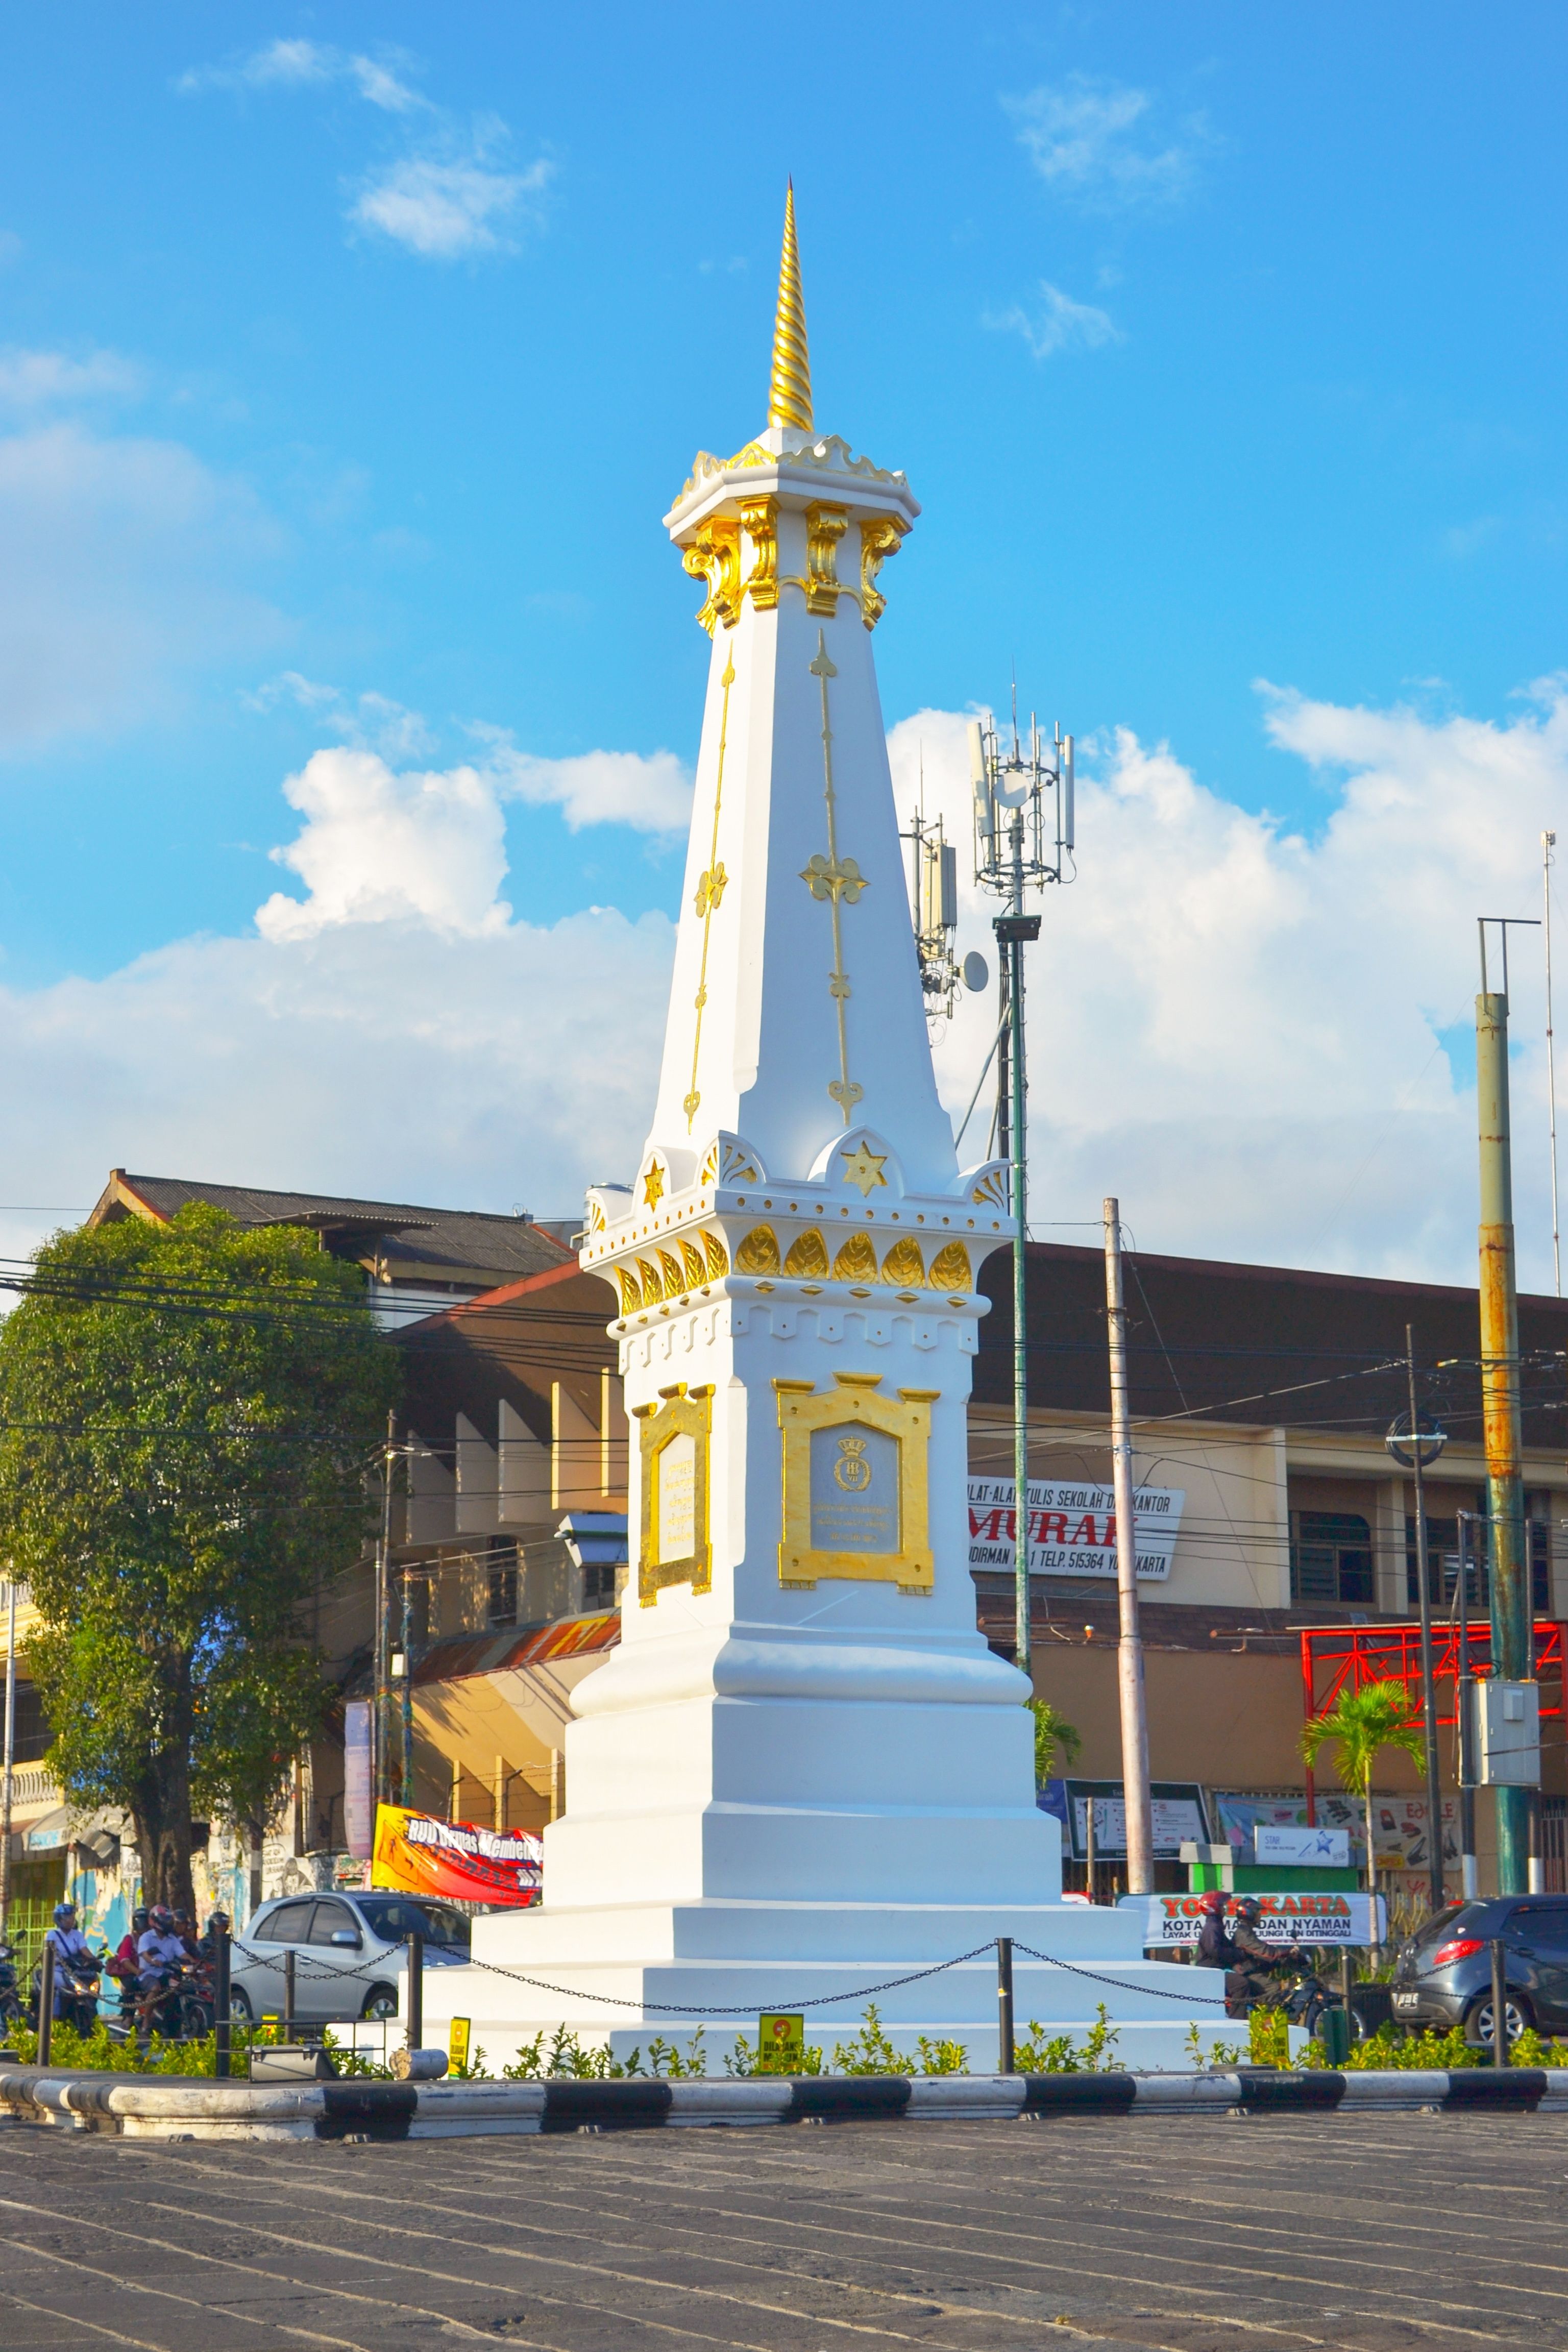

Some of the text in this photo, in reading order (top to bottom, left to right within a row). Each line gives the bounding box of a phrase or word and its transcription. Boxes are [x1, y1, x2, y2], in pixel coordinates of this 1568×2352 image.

[1058, 1489, 1104, 1509] SEKOLAH
[1133, 1495, 1170, 1512] KANTOR
[1040, 1551, 1065, 1567] TELP.
[1069, 1552, 1104, 1570] 515364
[1160, 1895, 1351, 1918] YOYKARTA
[1163, 1921, 1202, 1931] KOTA
[1293, 1919, 1350, 1929] NYAMAN
